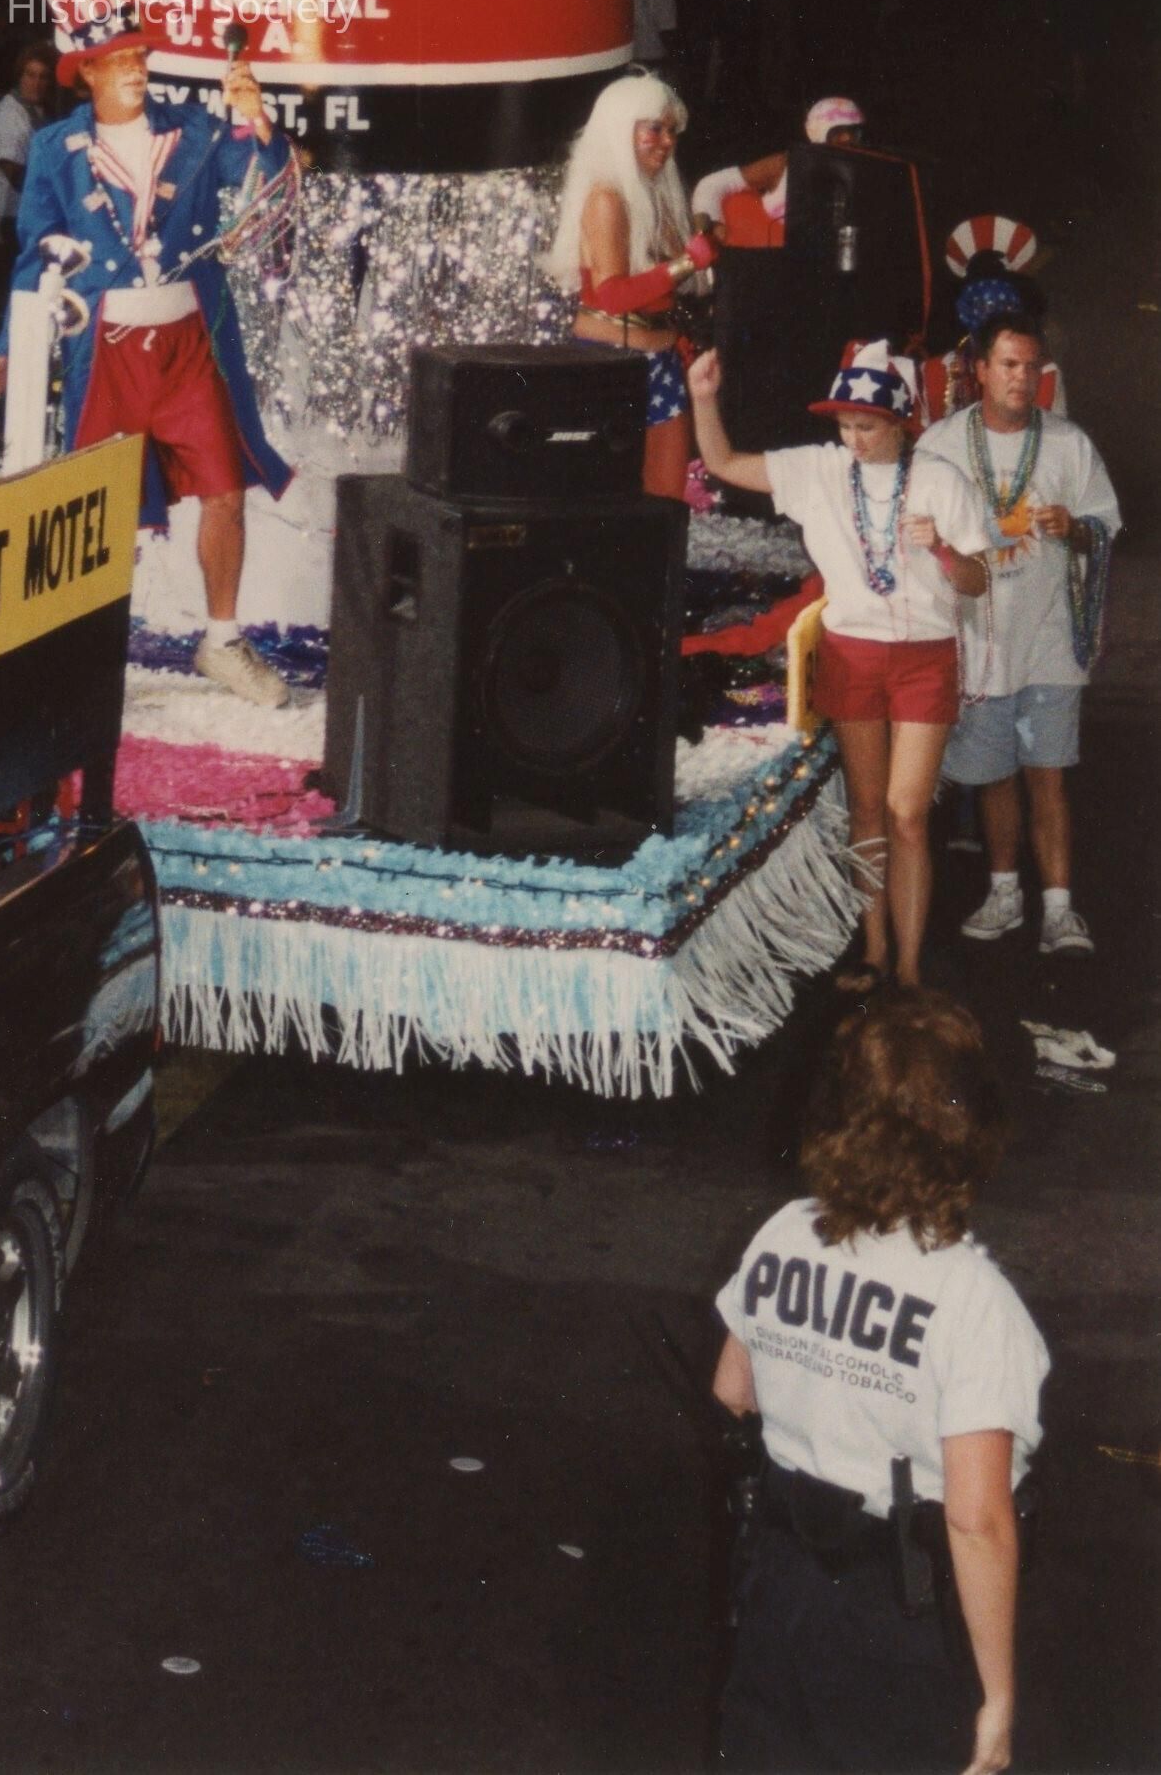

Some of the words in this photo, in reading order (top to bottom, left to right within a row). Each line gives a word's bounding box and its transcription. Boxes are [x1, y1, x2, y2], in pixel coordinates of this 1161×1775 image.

[325, 94, 370, 131] FL
[24, 486, 110, 601] MOTEL
[744, 1251, 936, 1367] POLICE
[839, 1369, 917, 1405] TOBACCO
